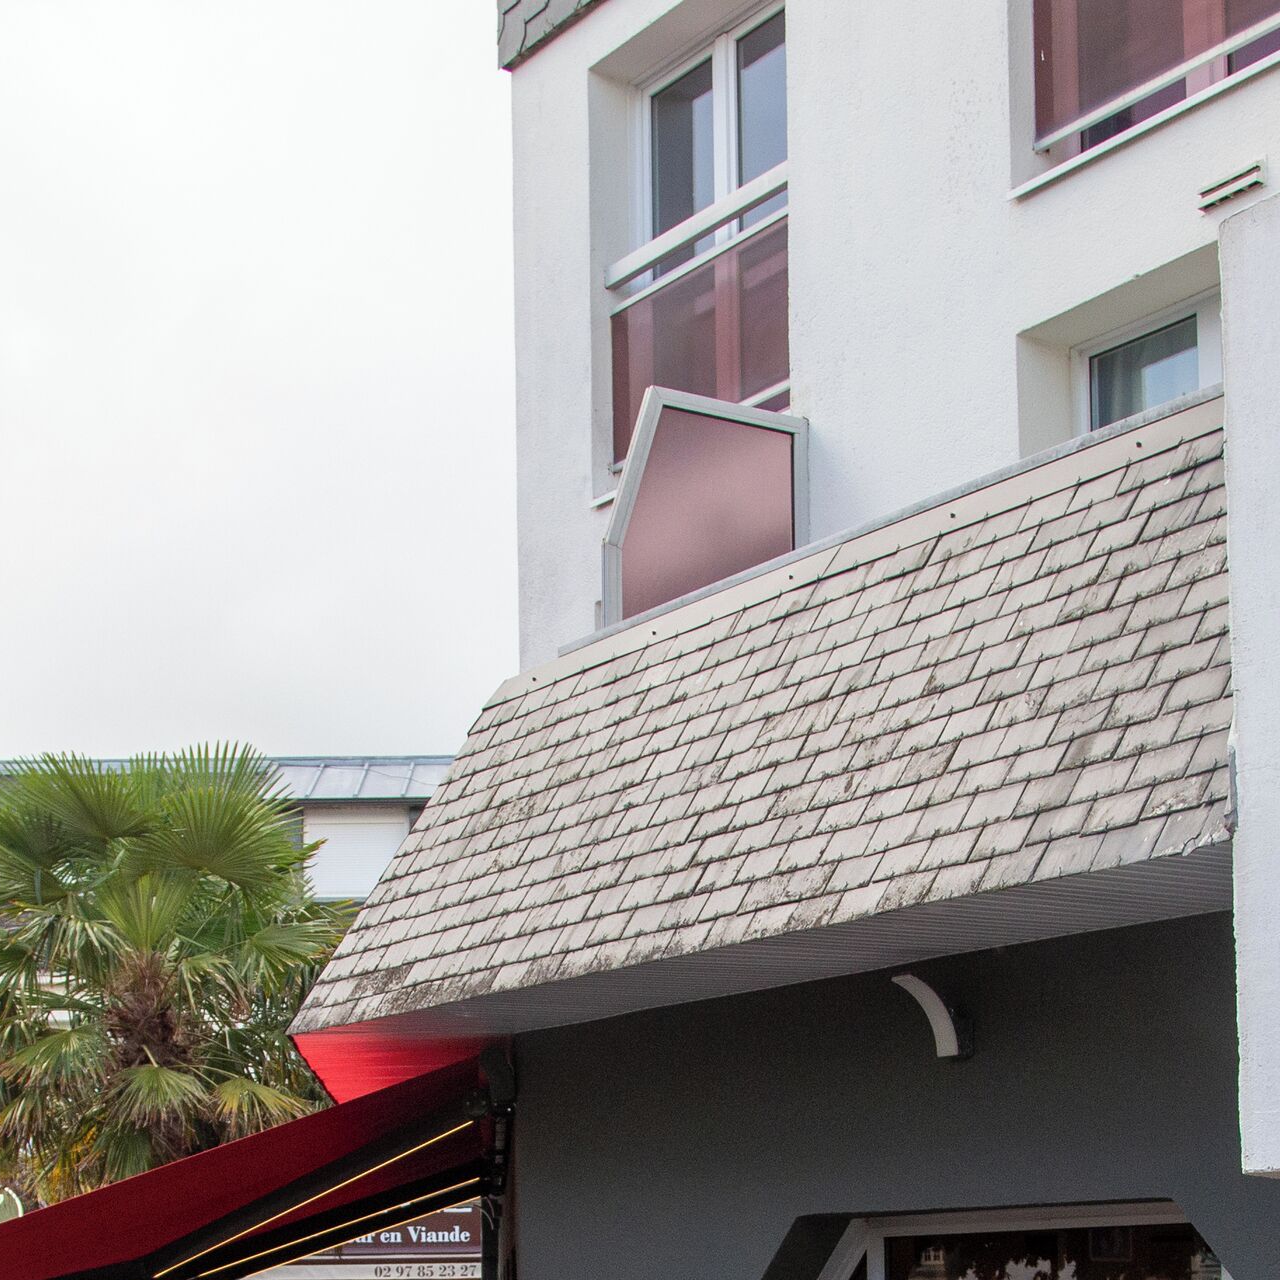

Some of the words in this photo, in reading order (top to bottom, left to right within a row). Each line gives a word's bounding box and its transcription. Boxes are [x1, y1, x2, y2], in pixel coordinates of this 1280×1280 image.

[380, 1231, 402, 1243] en
[407, 1226, 471, 1243] Viande
[374, 1266, 391, 1278] 02
[396, 1266, 413, 1277] 97
[418, 1265, 434, 1277] 85
[439, 1265, 456, 1277] 23
[460, 1265, 477, 1276] 27
